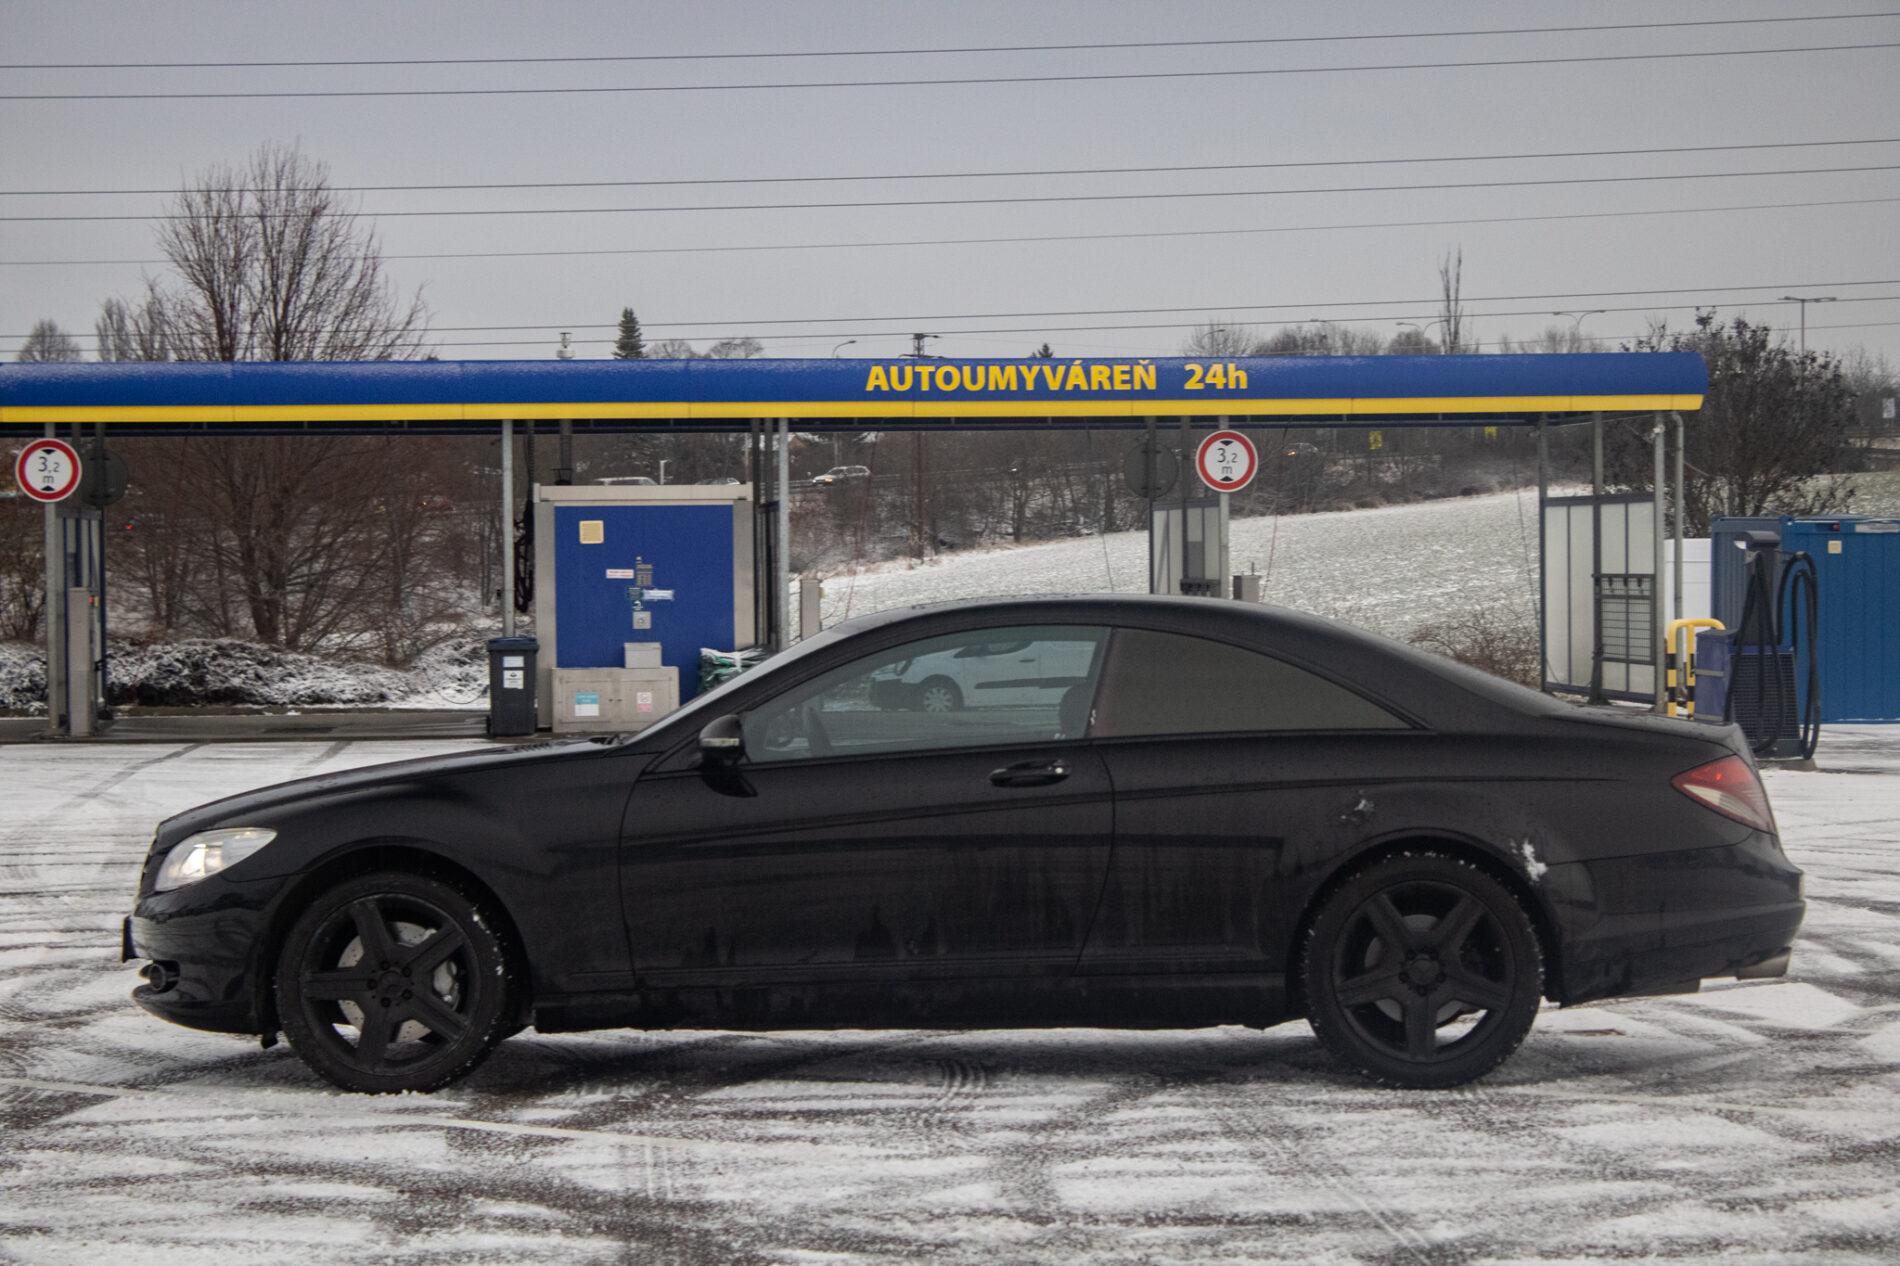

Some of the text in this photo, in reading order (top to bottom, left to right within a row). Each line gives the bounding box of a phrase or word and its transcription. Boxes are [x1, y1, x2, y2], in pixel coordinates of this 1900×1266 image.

[866, 360, 1248, 391] AUTOUMYVÁREŇ 24h
[1221, 466, 1233, 474] m
[43, 475, 54, 484] m
